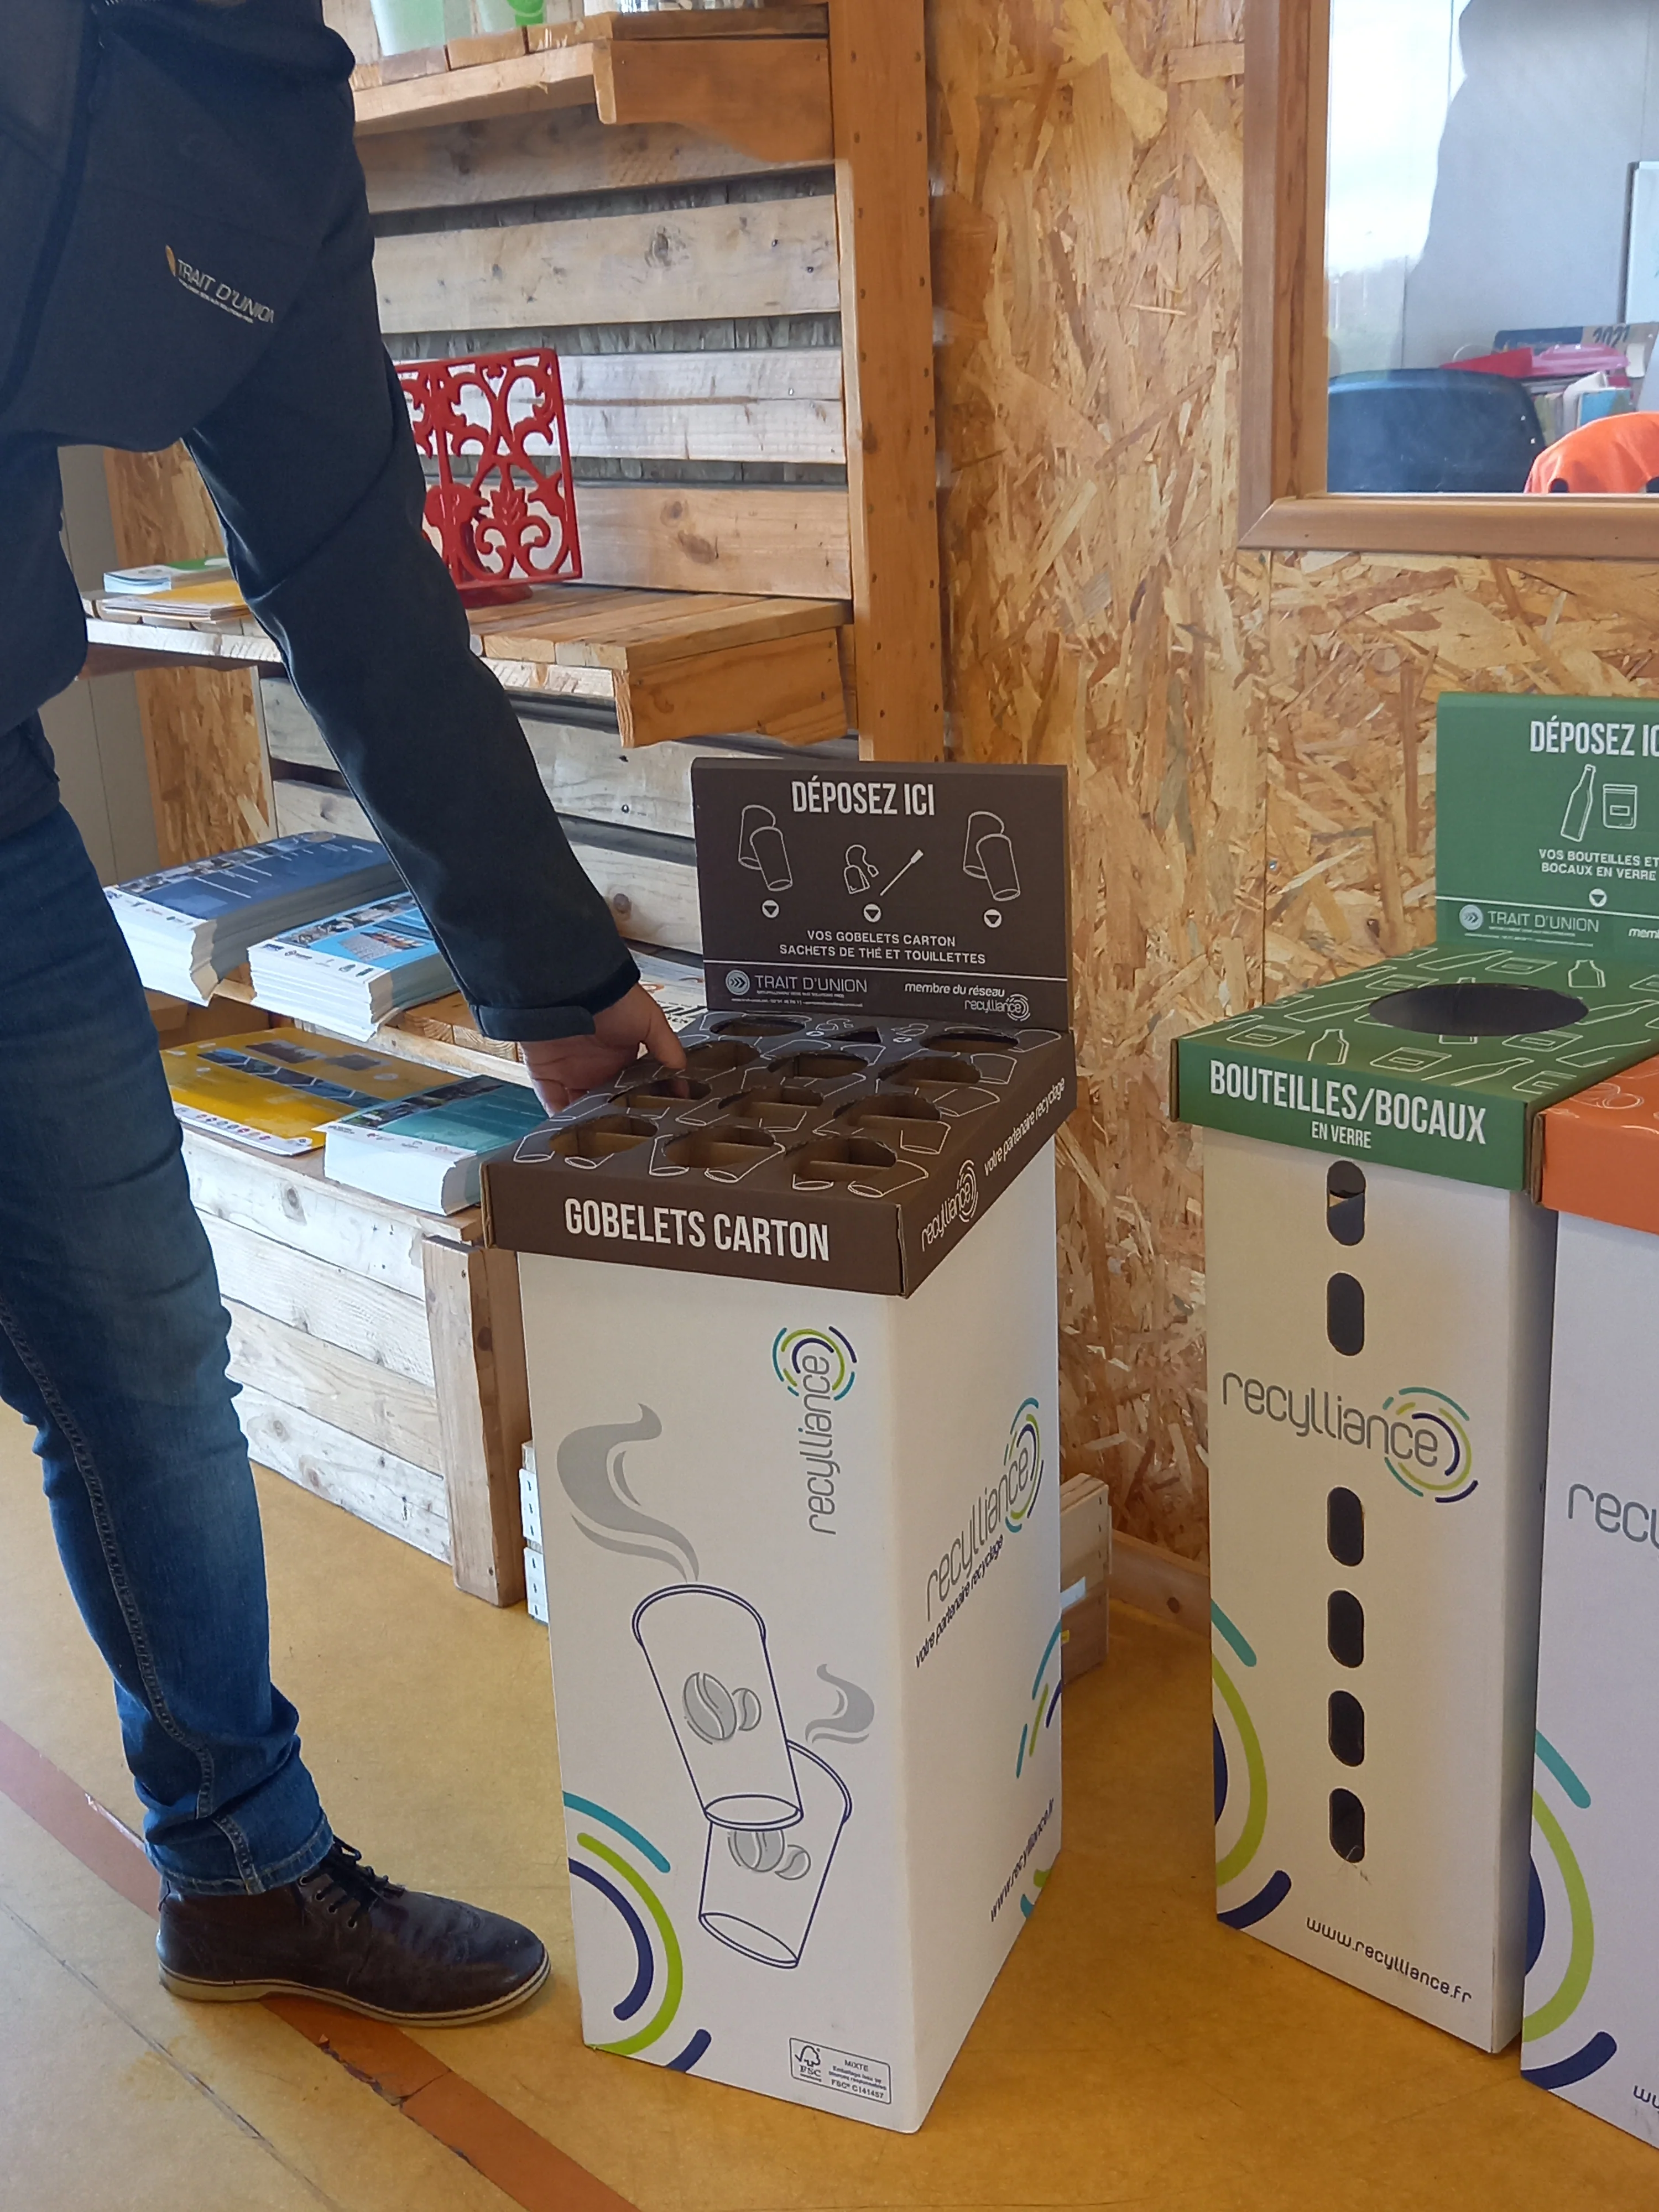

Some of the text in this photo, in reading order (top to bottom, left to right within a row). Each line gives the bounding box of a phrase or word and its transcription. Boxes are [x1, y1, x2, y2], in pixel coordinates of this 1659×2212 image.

[178, 258, 216, 291] TRAIT
[1530, 714, 1635, 756] DÉPOSEZ
[791, 775, 935, 816] DÉPOSEZ ICI
[1539, 848, 1659, 868] VOS BOUTEILLES ET
[1541, 862, 1657, 881] BOCAUX EN VERRE
[807, 930, 956, 947] VOS GOBELETS CARTON
[1488, 911, 1530, 926] TRAIT
[1535, 914, 1600, 932] D'UNION
[779, 944, 985, 964] SACHETS DE THÉ ET TOUILLETTES
[754, 975, 867, 993] TRAIT D'UNION
[905, 983, 1005, 998] membre du réseau
[964, 997, 1021, 1013] recylliance
[1210, 1060, 1486, 1144] BOUTEILLES/BOCAUX
[984, 1077, 1065, 1176] votre partenaire recyclage
[1312, 1121, 1372, 1149] EN VERRE
[565, 1198, 830, 1261] GOBELETS CARTON
[921, 1182, 971, 1252] recylliance
[1223, 1371, 1438, 1467] recylliance
[797, 1354, 841, 1535] recylliance
[926, 1447, 1029, 1622] recylliance
[916, 1632, 936, 1668] votre
[1306, 1917, 1472, 2004] www.recylliance.fr
[844, 2059, 869, 2072] MIXTE
